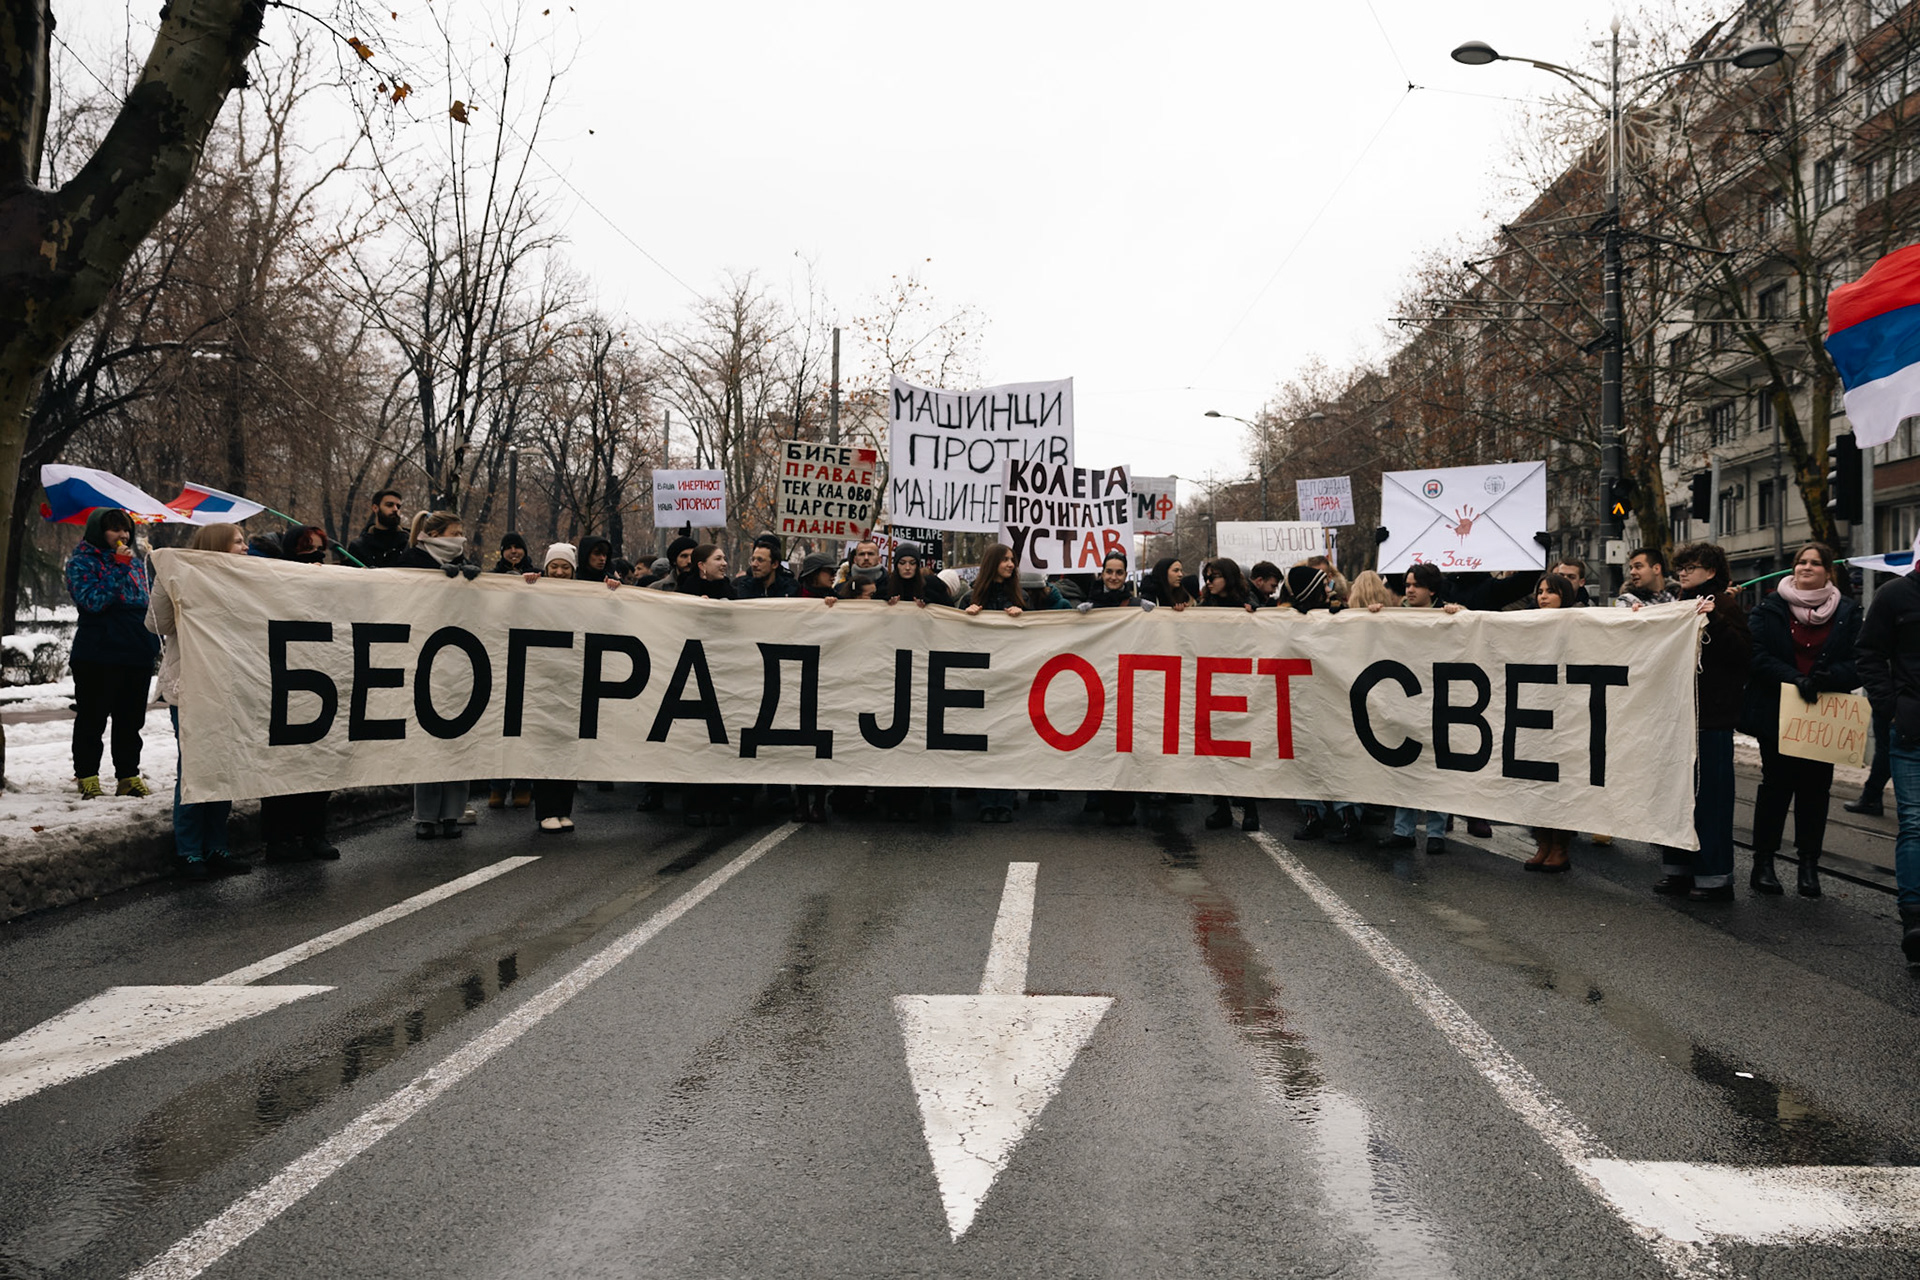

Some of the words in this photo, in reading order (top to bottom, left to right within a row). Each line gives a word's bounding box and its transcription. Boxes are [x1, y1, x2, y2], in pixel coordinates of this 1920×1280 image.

[894, 388, 1062, 431] МАШИНЦИ
[787, 443, 852, 466] БИЋЕ
[910, 434, 1068, 474] ПРОТИВ
[677, 480, 721, 491] ИНЕРТНОСТ
[785, 461, 872, 485] ПРАВДЕ
[674, 497, 722, 511] УПОРНОСТ
[782, 480, 811, 496] ТЕК
[817, 483, 843, 499] КАД
[848, 486, 872, 502] ОВО
[893, 478, 1001, 523] МАШИНЕ
[1004, 495, 1128, 527] ПРОЧИТАЈТЕ
[892, 527, 915, 540] АБЕ,
[916, 528, 942, 540] ЦАРЕ
[1006, 526, 1127, 569] УСТАВ
[268, 620, 833, 759] БЕОГРАД
[858, 648, 990, 751] ЈЕ
[1028, 653, 1313, 759] ОПЕТ
[1349, 659, 1629, 787] СВЕТ
[1782, 717, 1833, 748] ДОБРО
[1837, 726, 1865, 754] САМ
